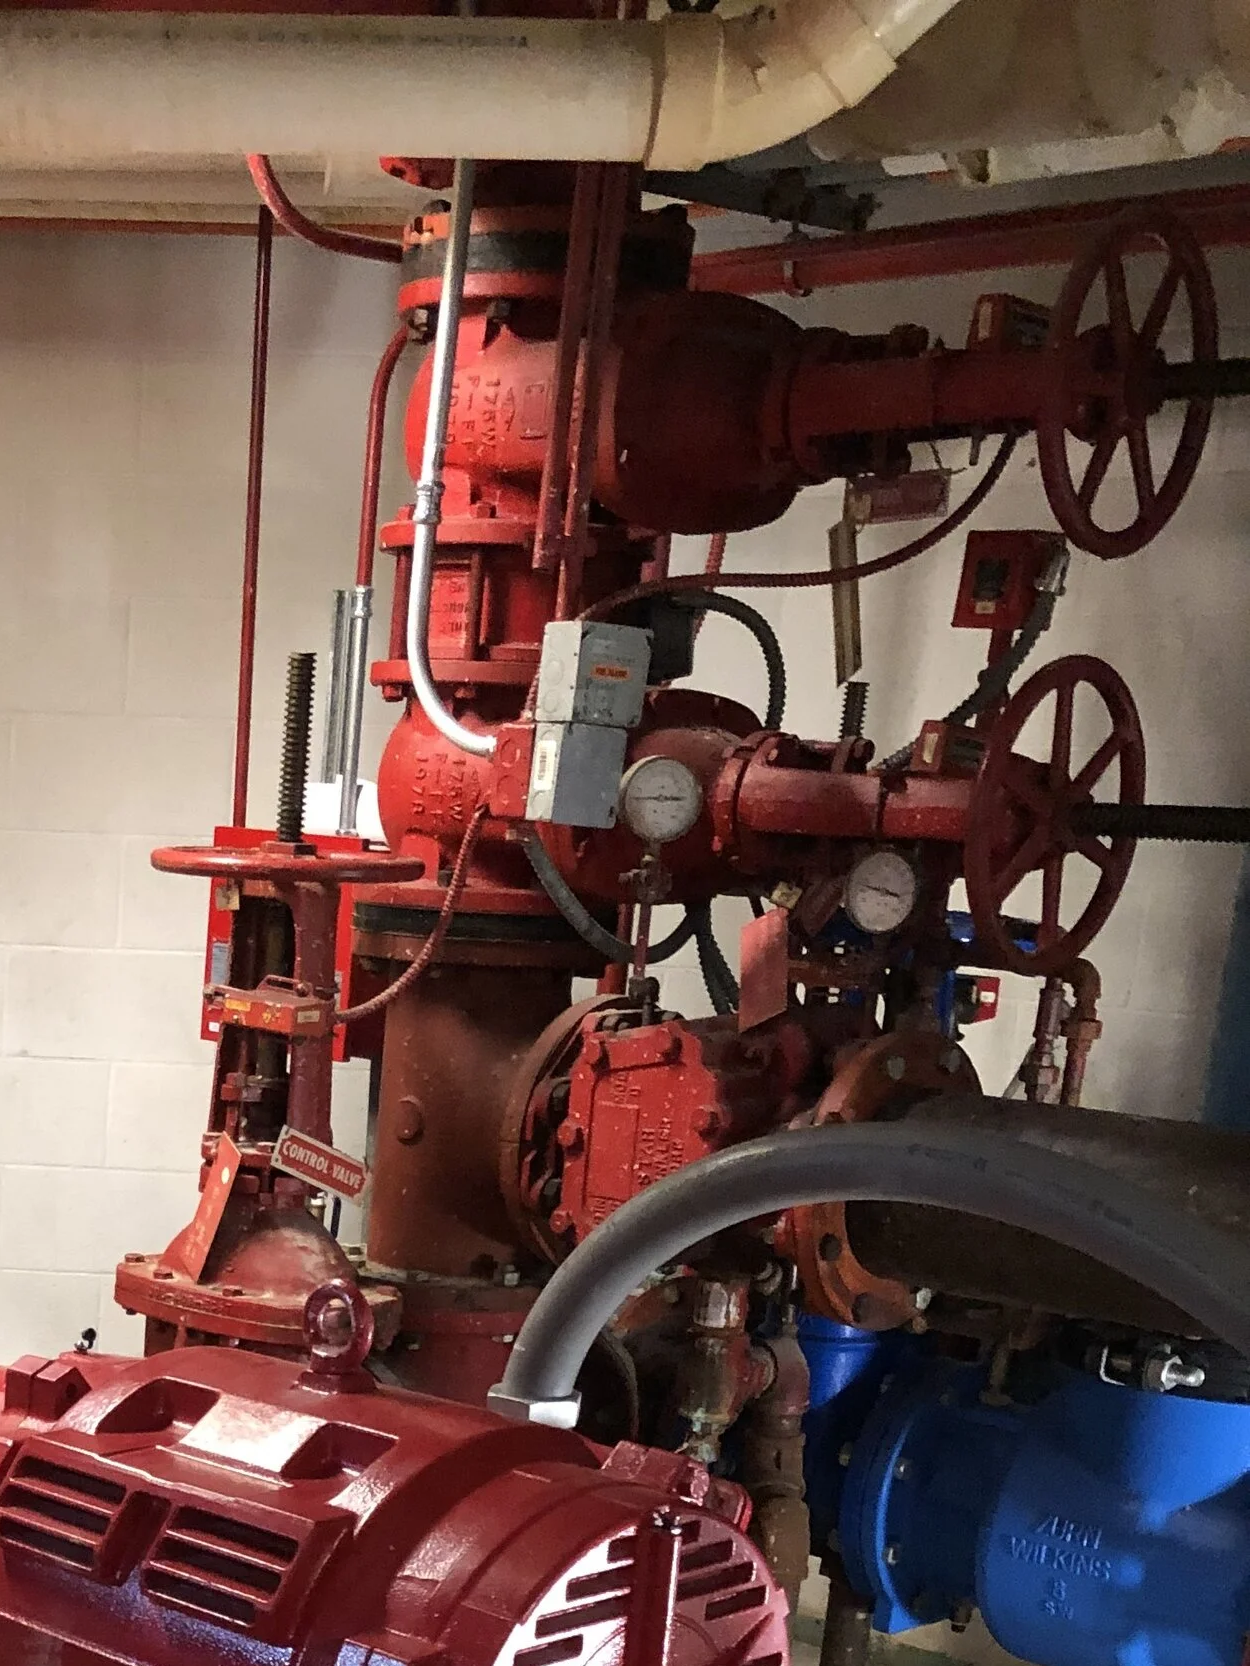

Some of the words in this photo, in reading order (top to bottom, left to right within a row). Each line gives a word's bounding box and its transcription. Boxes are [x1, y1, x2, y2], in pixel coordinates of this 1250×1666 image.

[282, 1140, 330, 1175] CONTROL
[331, 1163, 362, 1190] VALVE
[1010, 1536, 1112, 1580] WILKINS
